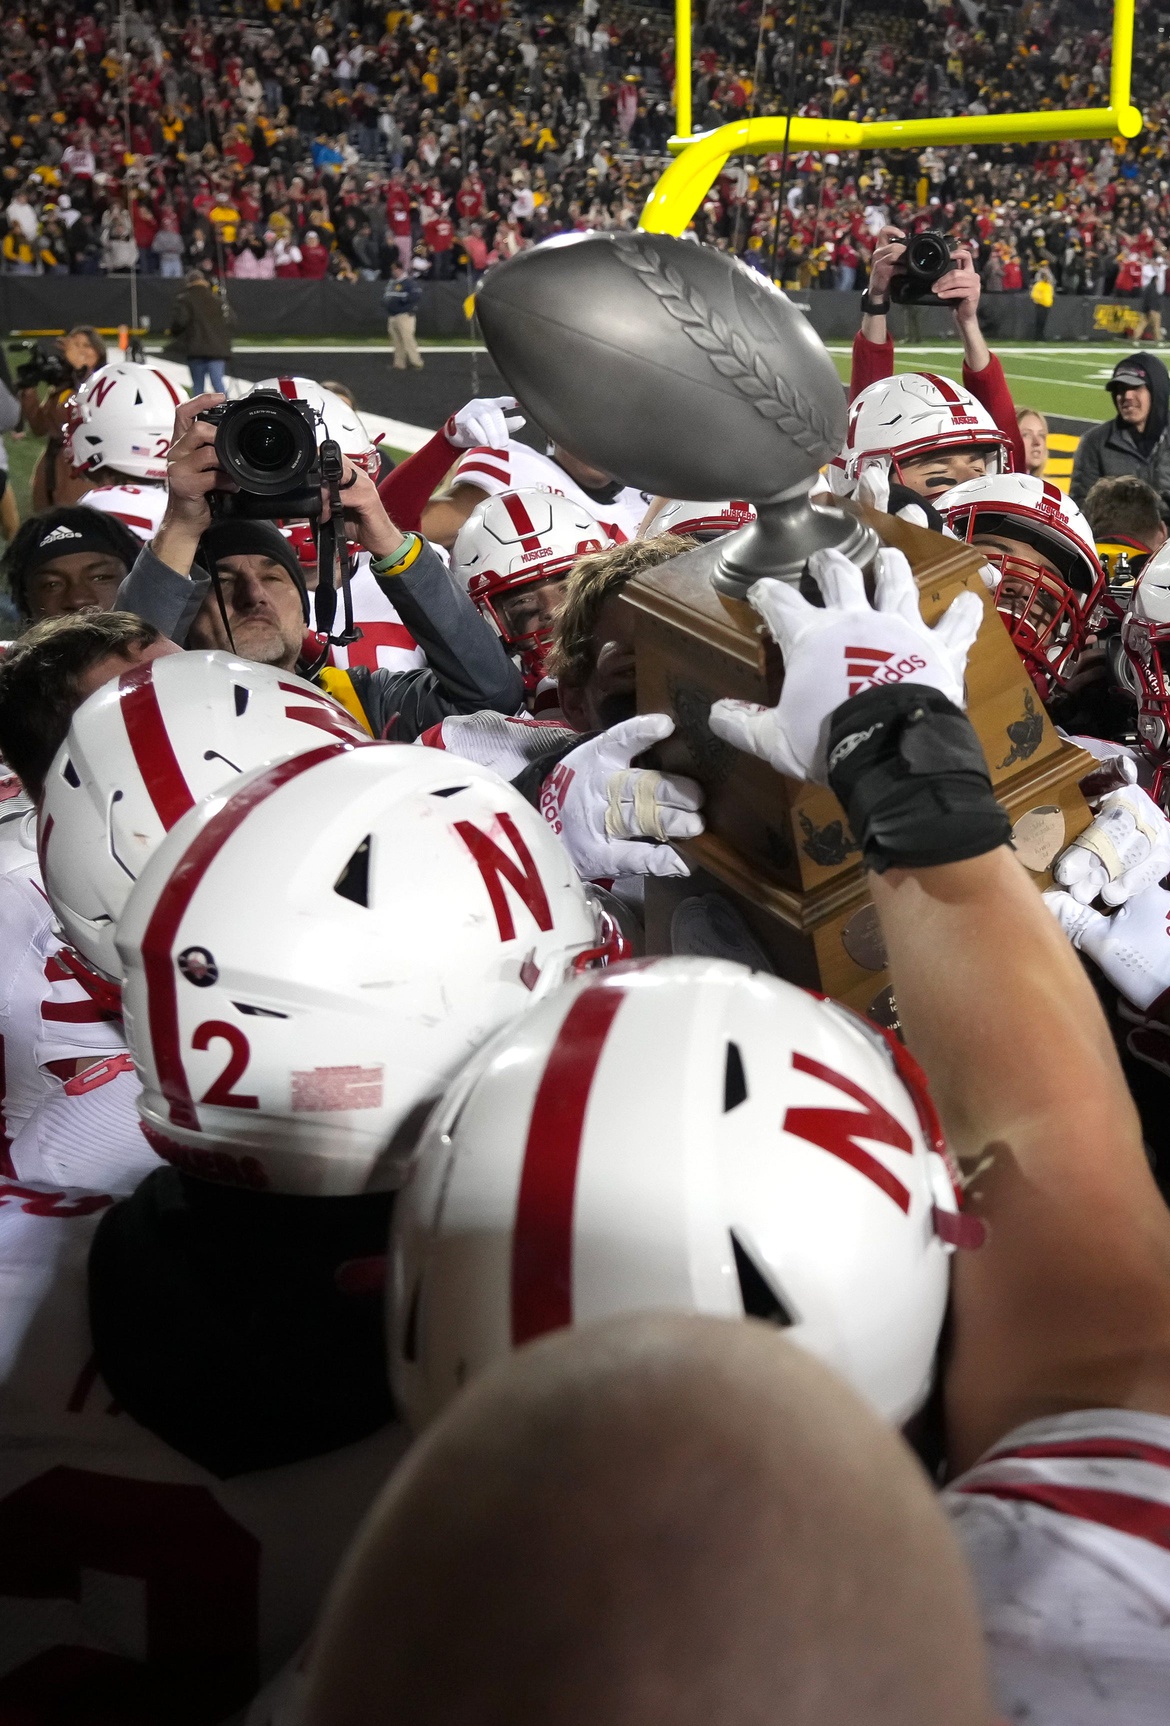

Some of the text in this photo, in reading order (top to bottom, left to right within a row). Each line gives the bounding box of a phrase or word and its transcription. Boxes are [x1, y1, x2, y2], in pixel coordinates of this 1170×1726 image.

[86, 376, 117, 408] N
[1035, 500, 1069, 523] HUSKERS
[40, 532, 83, 548] adidas
[520, 546, 554, 564] HUSKERS
[867, 653, 927, 691] idas
[453, 812, 554, 942] N
[192, 1020, 260, 1109] 2
[784, 1049, 914, 1214] N
